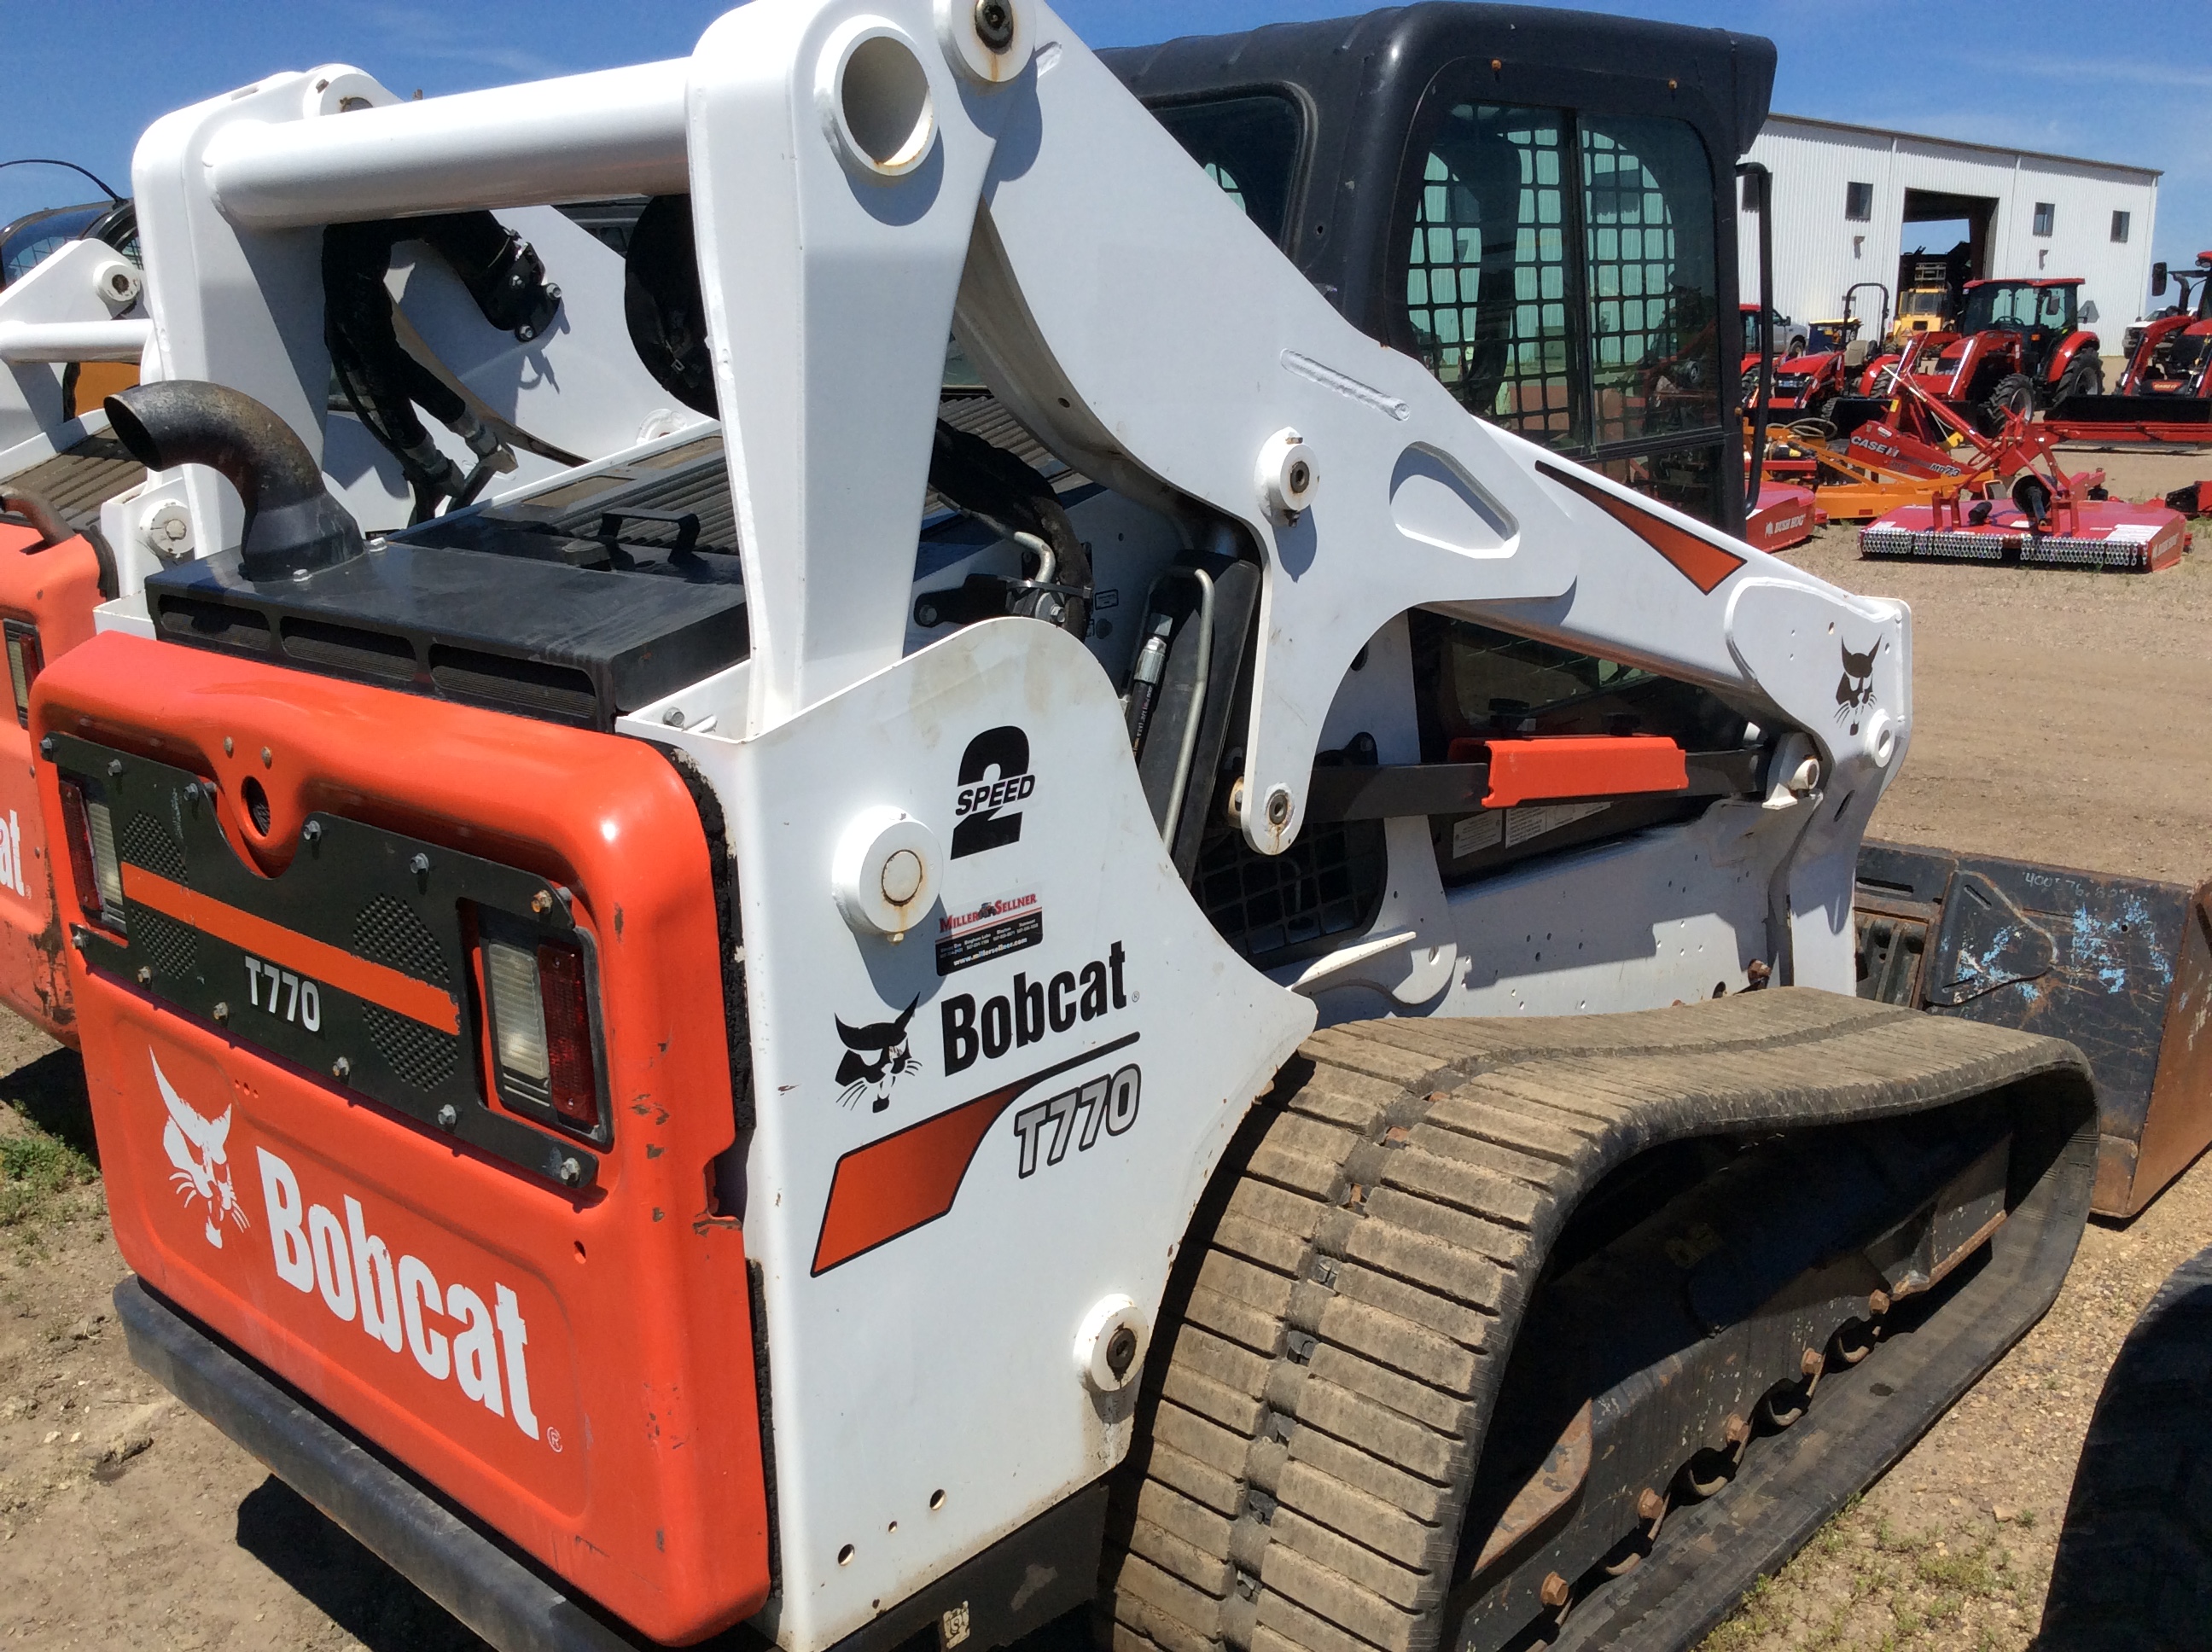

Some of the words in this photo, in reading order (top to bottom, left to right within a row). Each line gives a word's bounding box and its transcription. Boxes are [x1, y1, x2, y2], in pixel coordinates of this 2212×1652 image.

[1850, 435, 1886, 455] CASE
[950, 725, 1030, 860] 2
[955, 774, 1036, 817] SPEED
[940, 914, 980, 933] MILLER
[994, 893, 1038, 916] SELLNER
[245, 955, 321, 1032] T770
[940, 939, 1127, 1076] Bobcat
[1013, 1062, 1142, 1179] T770
[255, 1145, 539, 1442] Bobcat
